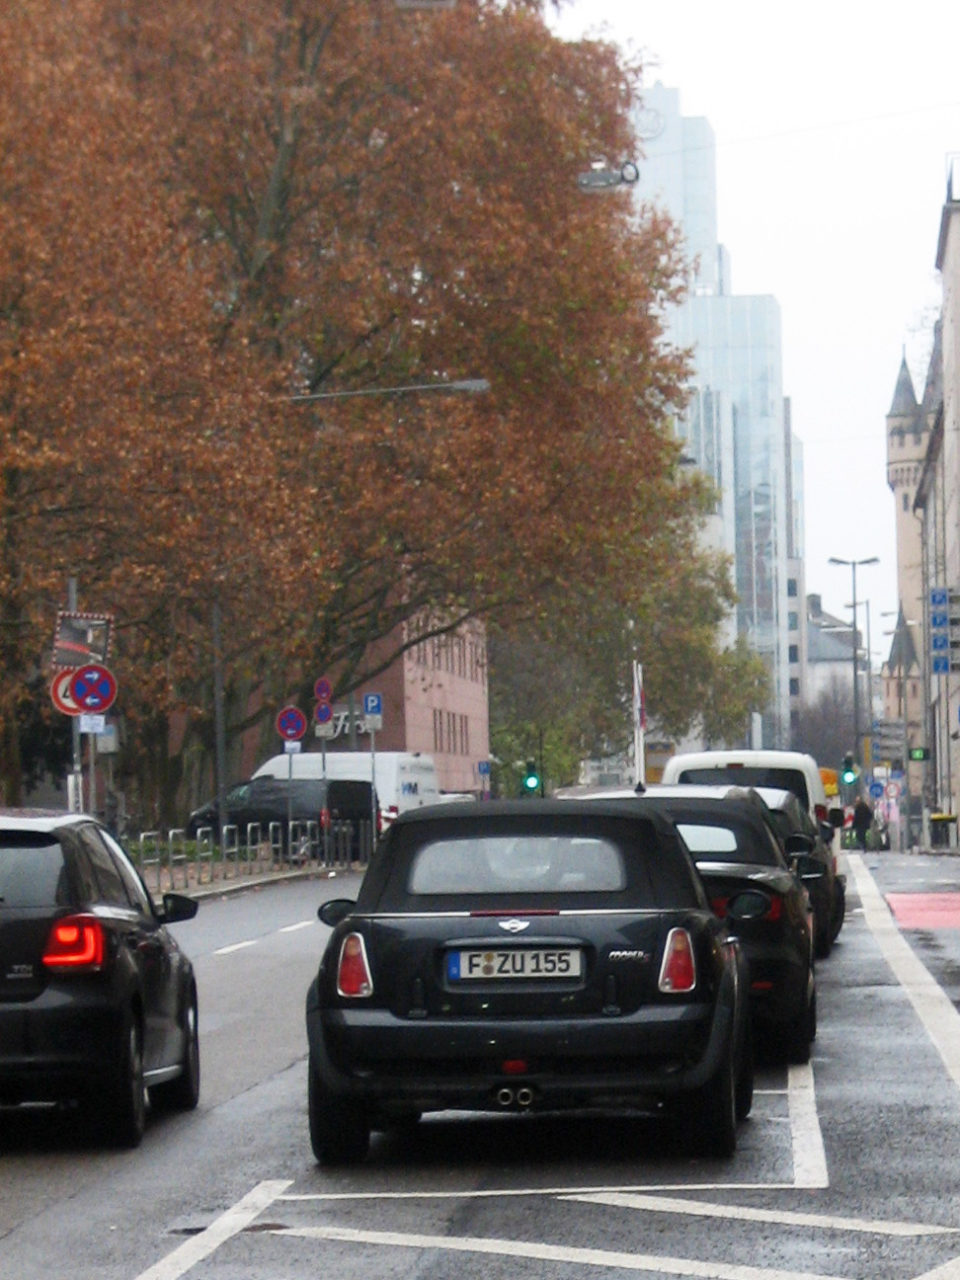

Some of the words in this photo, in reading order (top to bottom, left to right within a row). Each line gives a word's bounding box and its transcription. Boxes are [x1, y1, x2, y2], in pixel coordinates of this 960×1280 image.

[468, 953, 482, 974] F
[497, 953, 525, 974] ZU
[530, 952, 571, 973] 155
